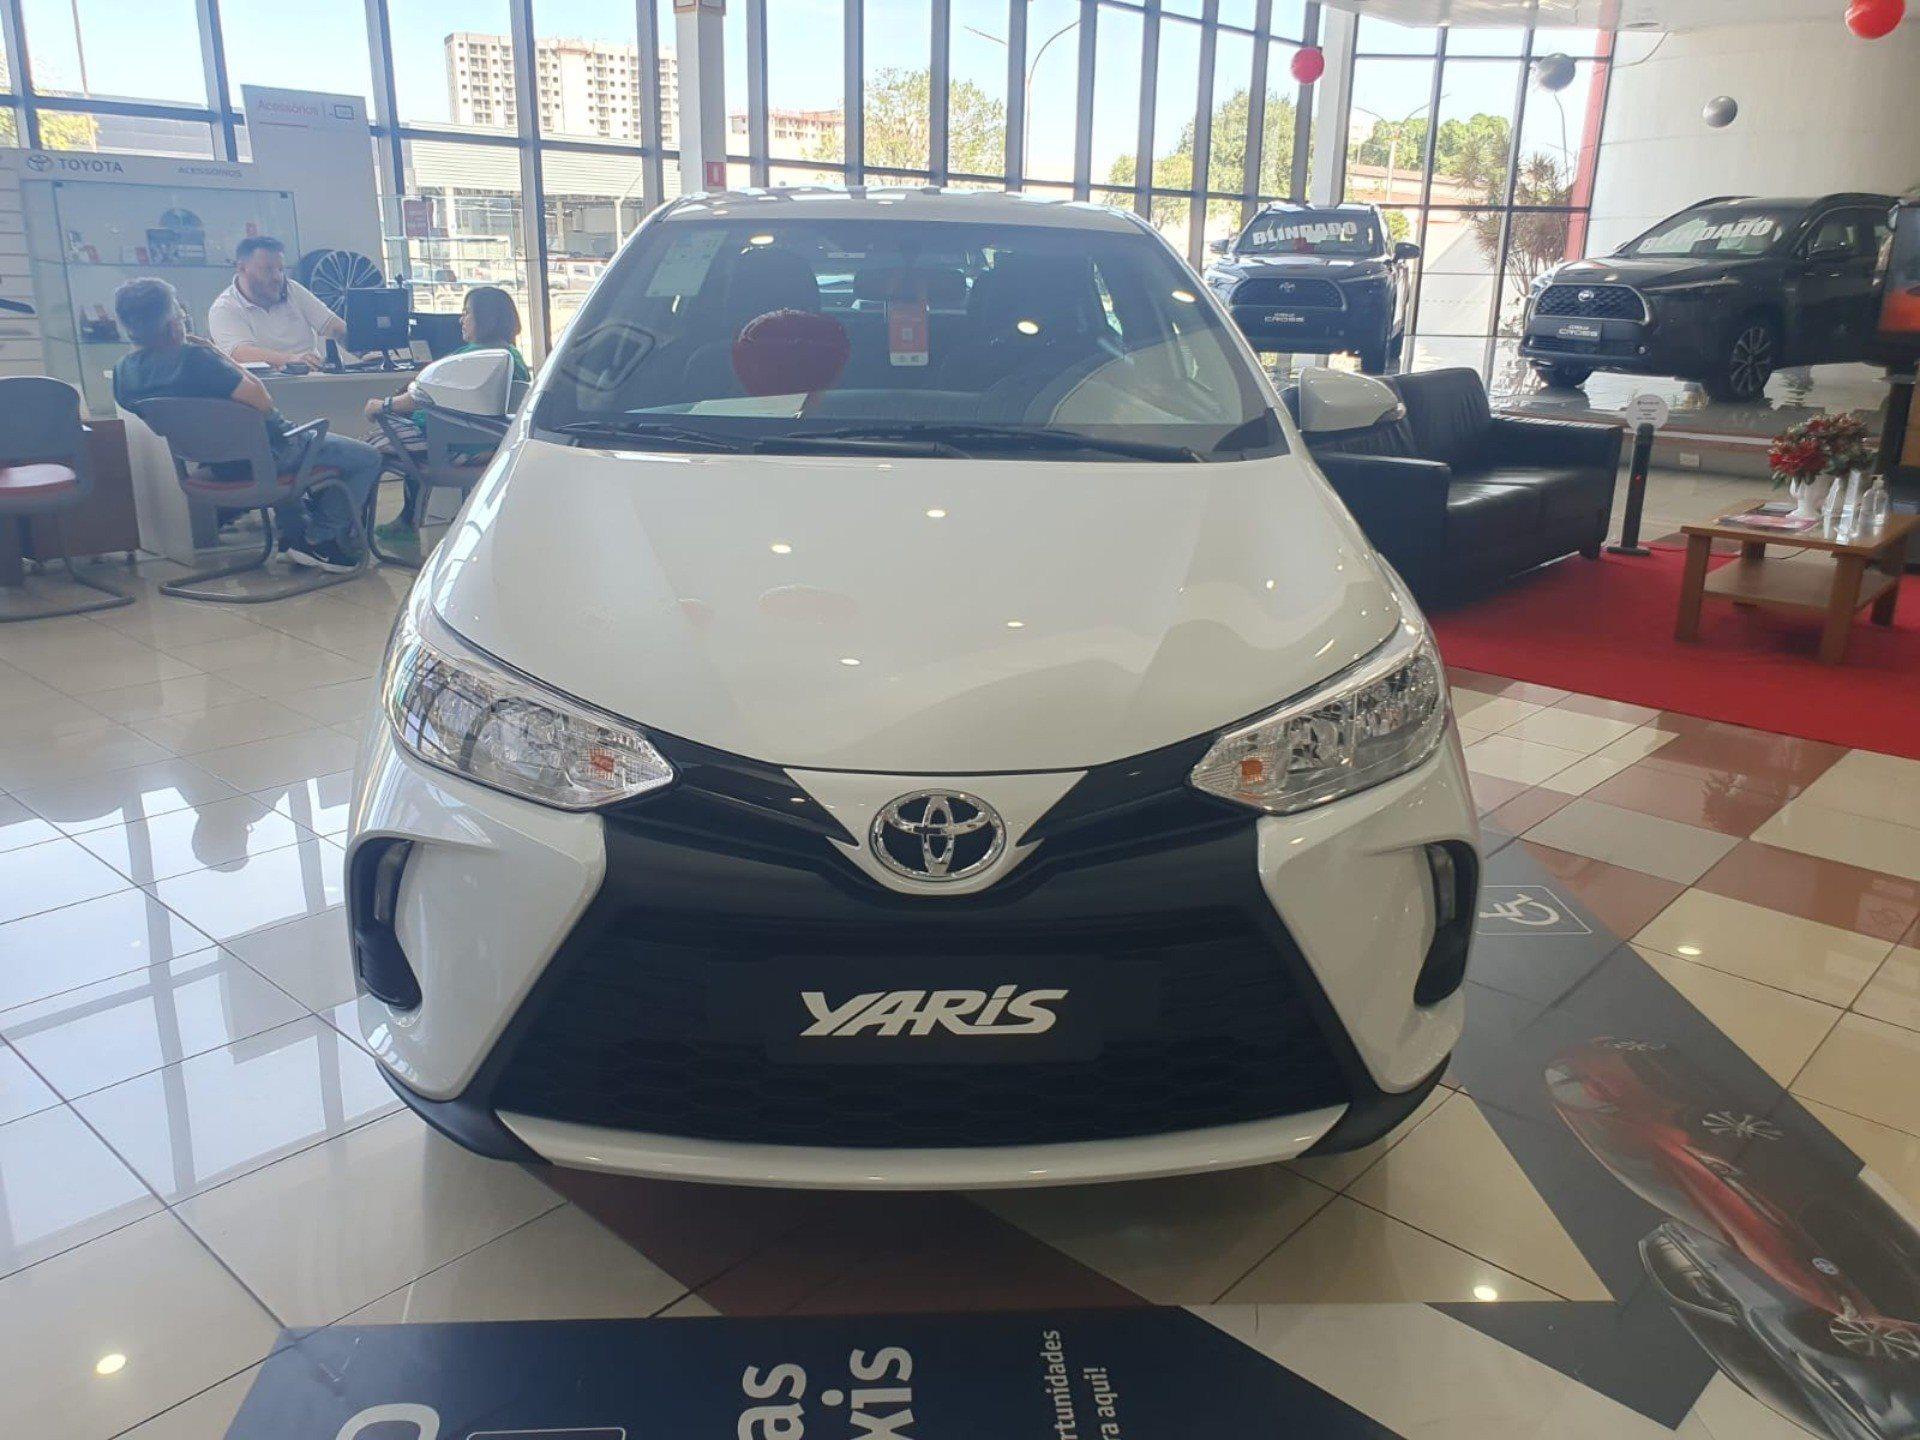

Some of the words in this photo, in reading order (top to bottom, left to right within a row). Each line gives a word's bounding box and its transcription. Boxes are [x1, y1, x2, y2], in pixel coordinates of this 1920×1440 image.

[59, 158, 124, 173] TOYOTA
[1252, 221, 1357, 246] BLINDADO
[1083, 1367, 1118, 1417] aqui!
